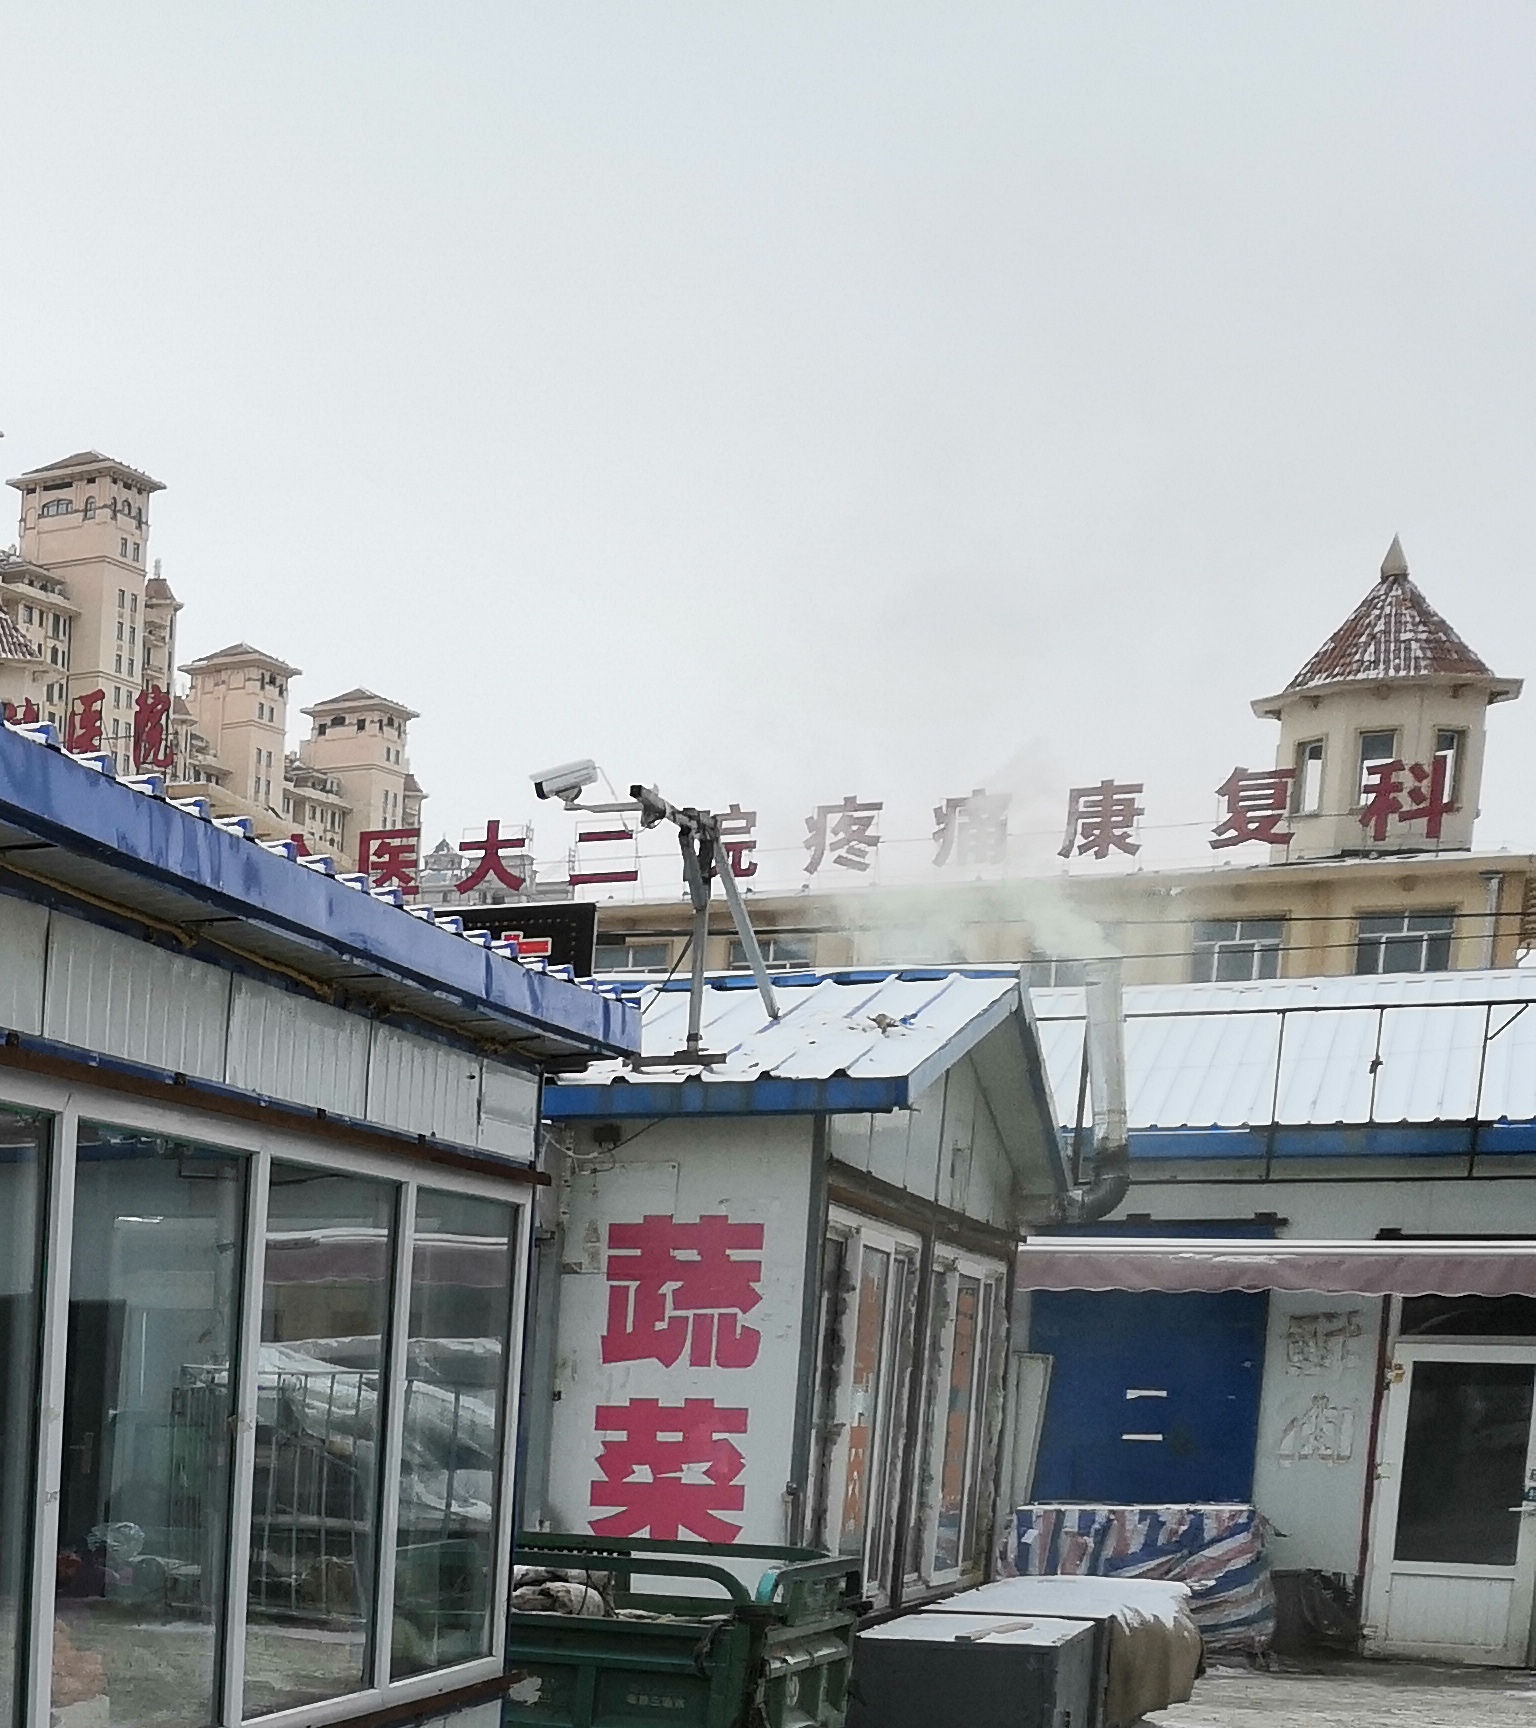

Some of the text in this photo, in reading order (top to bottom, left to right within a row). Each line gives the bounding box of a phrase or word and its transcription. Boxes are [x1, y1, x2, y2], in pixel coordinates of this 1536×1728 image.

[6, 684, 175, 768] 医院
[291, 754, 1460, 896] 医大二院疼痛康复科
[588, 1214, 765, 1544] 蔬菜
